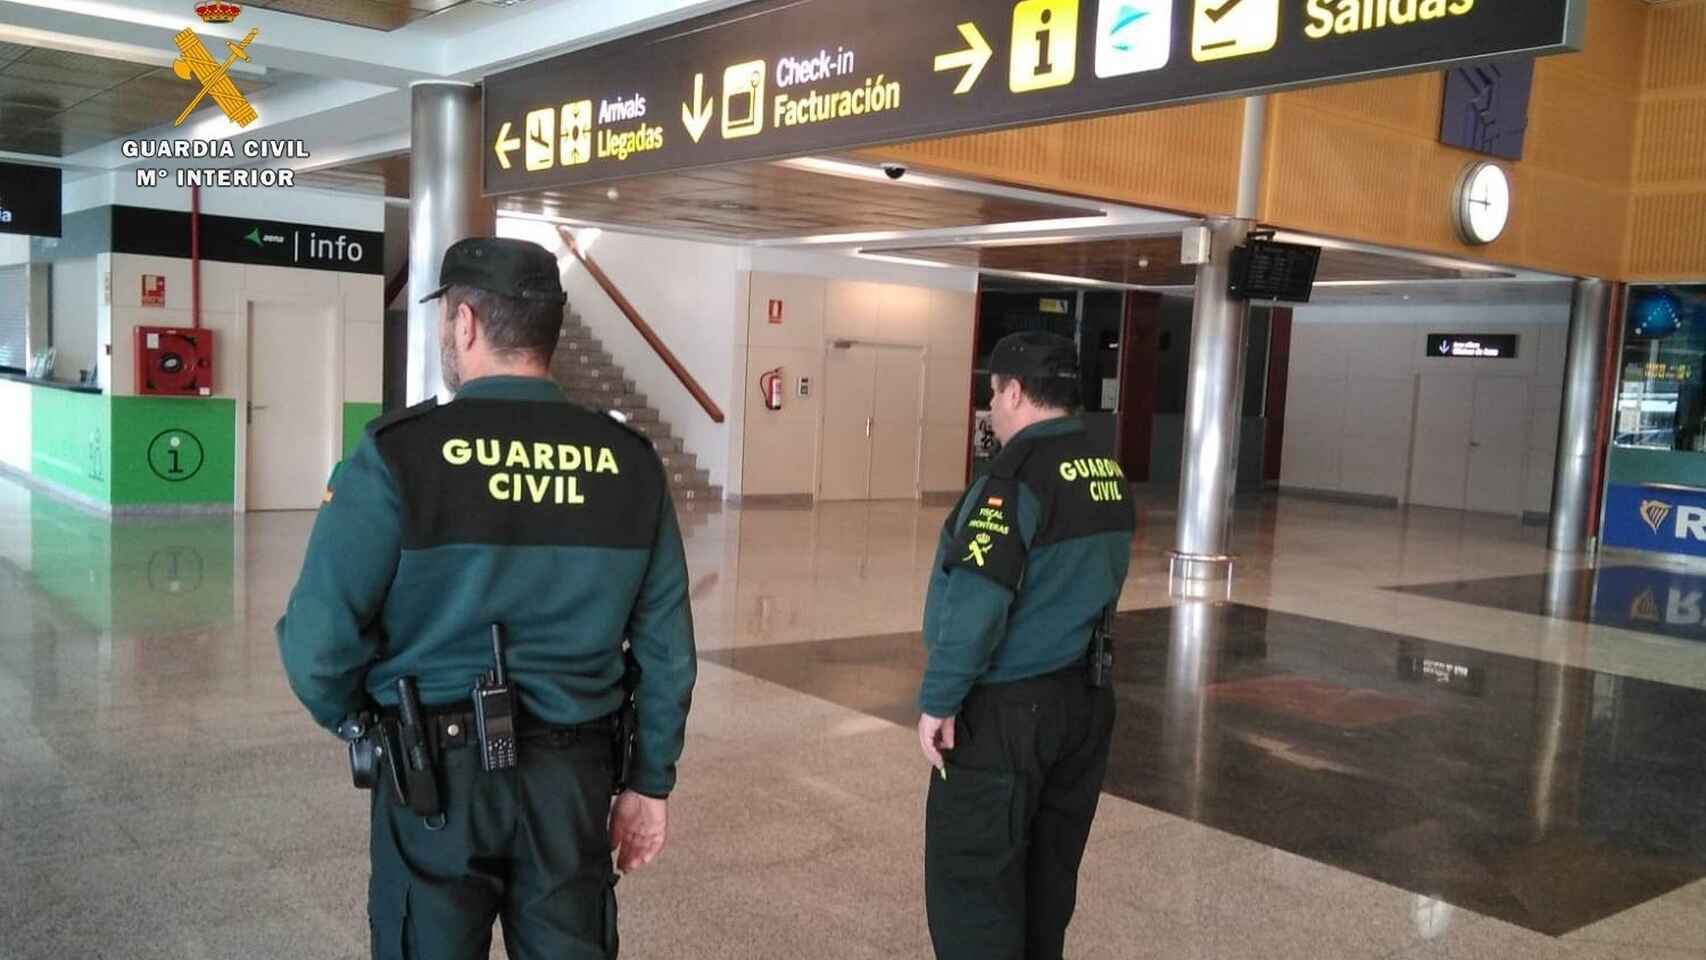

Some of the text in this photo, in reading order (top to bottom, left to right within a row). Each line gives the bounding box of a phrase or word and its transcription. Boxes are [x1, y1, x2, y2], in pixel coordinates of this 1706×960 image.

[776, 47, 854, 88] Check-in
[598, 92, 646, 125] Arrivals
[774, 74, 900, 128] Facturación
[597, 122, 663, 160] Llegadas
[309, 232, 363, 261] info
[442, 438, 619, 474] GUARDIA
[488, 473, 585, 504] CIVIL
[1089, 480, 1122, 501] CIVIL
